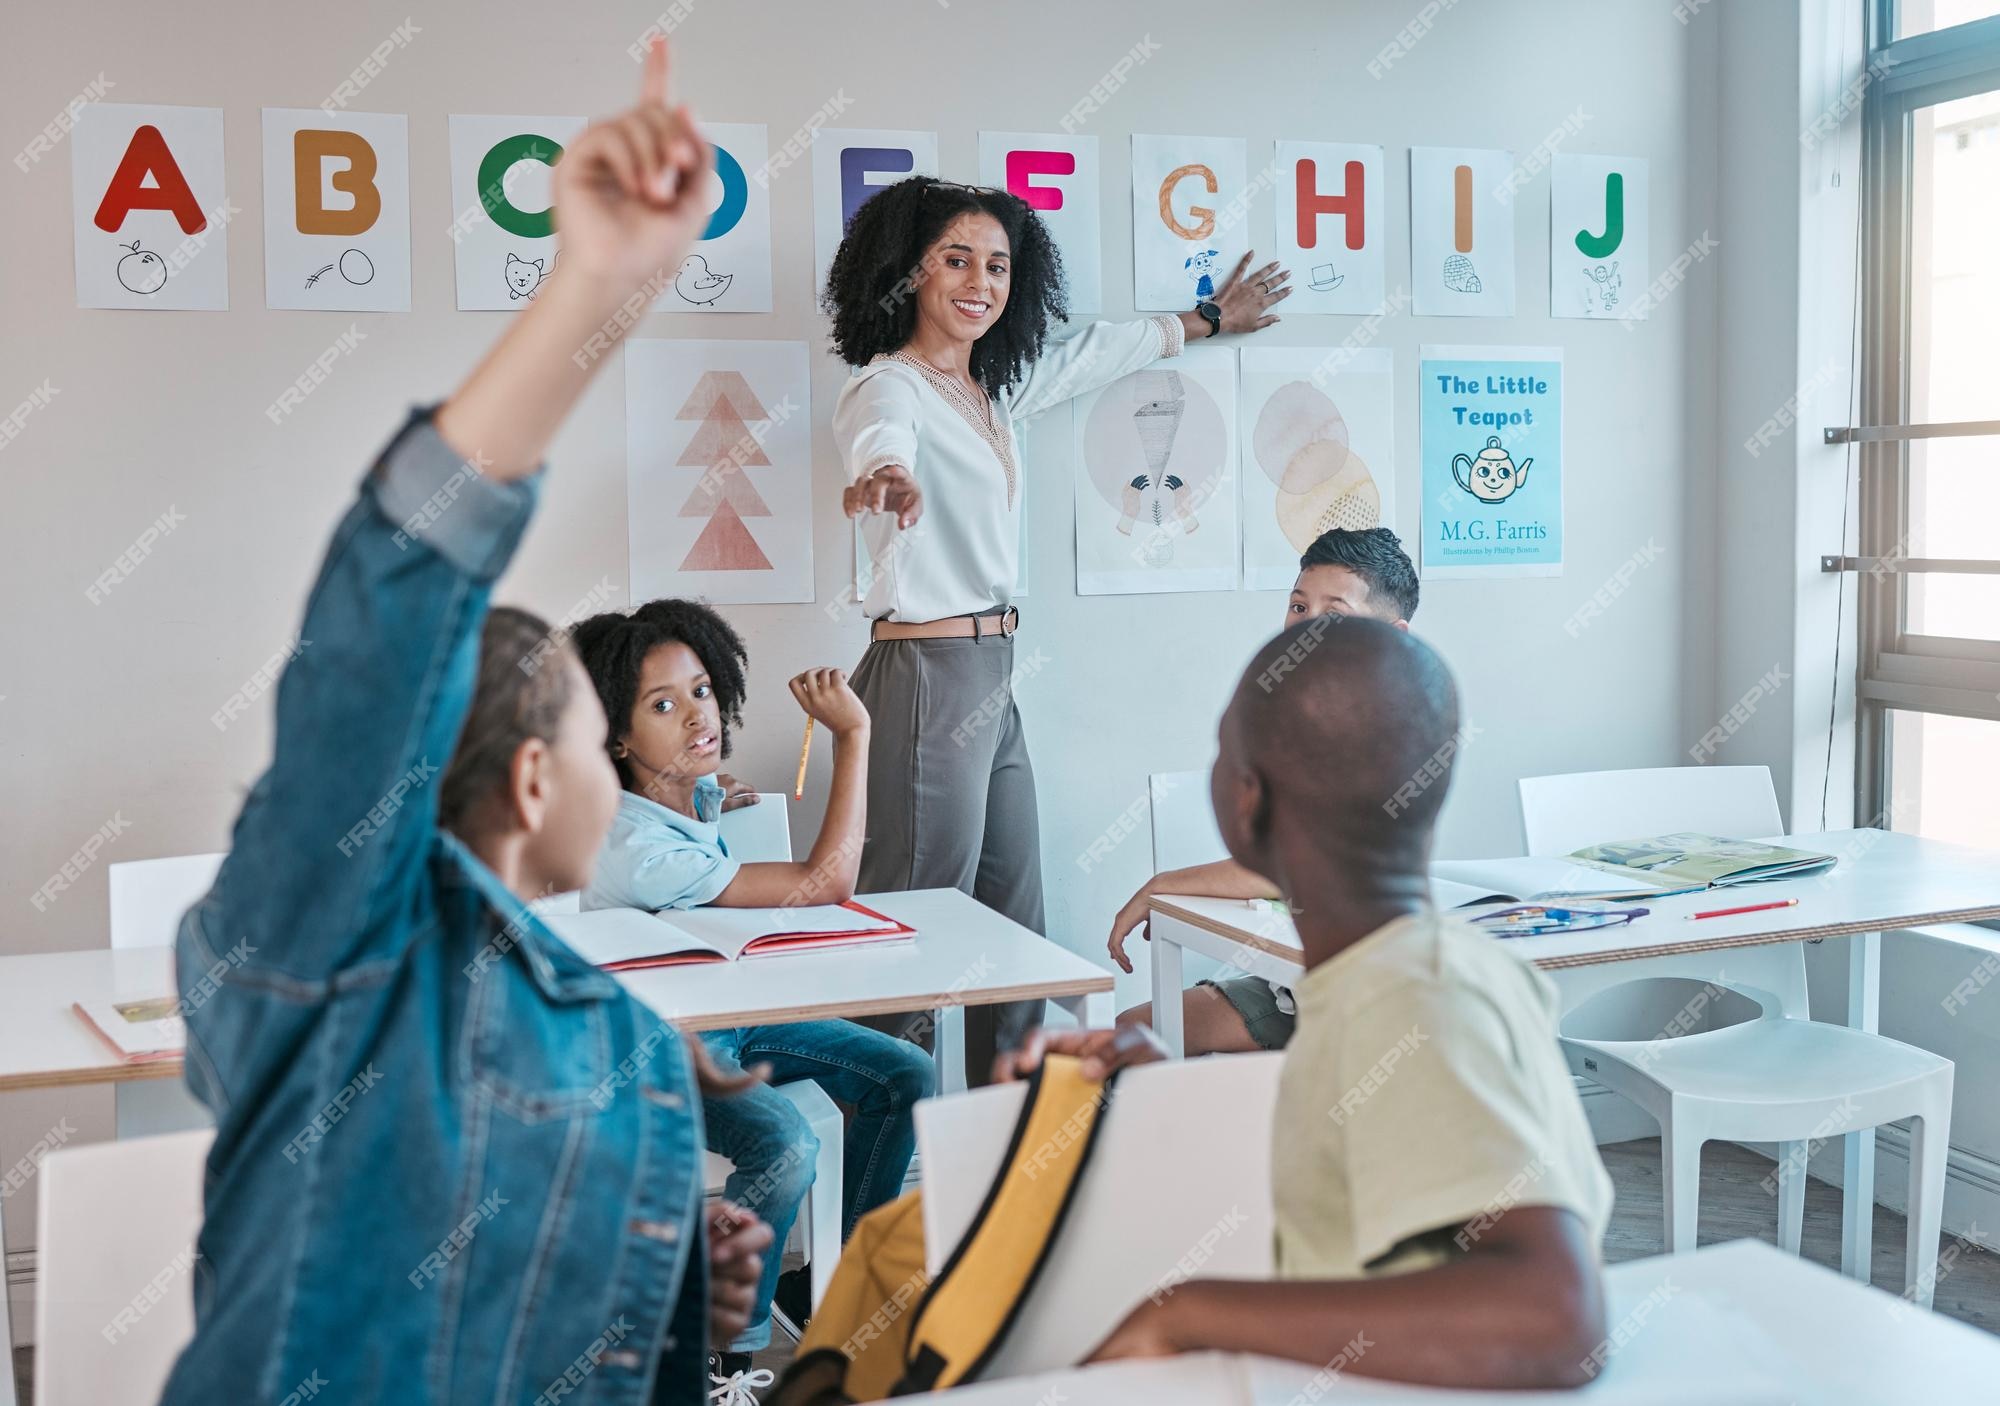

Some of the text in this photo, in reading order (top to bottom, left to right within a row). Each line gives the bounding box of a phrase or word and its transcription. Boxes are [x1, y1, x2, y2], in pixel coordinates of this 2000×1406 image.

[93, 124, 208, 235] A
[294, 129, 382, 236] B
[478, 134, 562, 238] C
[1159, 164, 1218, 240] G
[1296, 158, 1365, 250] H
[1454, 165, 1473, 253] I
[1575, 172, 1624, 259] J
[1437, 375, 1548, 394] The Little
[1452, 407, 1533, 431] Teapot
[1440, 520, 1547, 541] M.G. Farris
